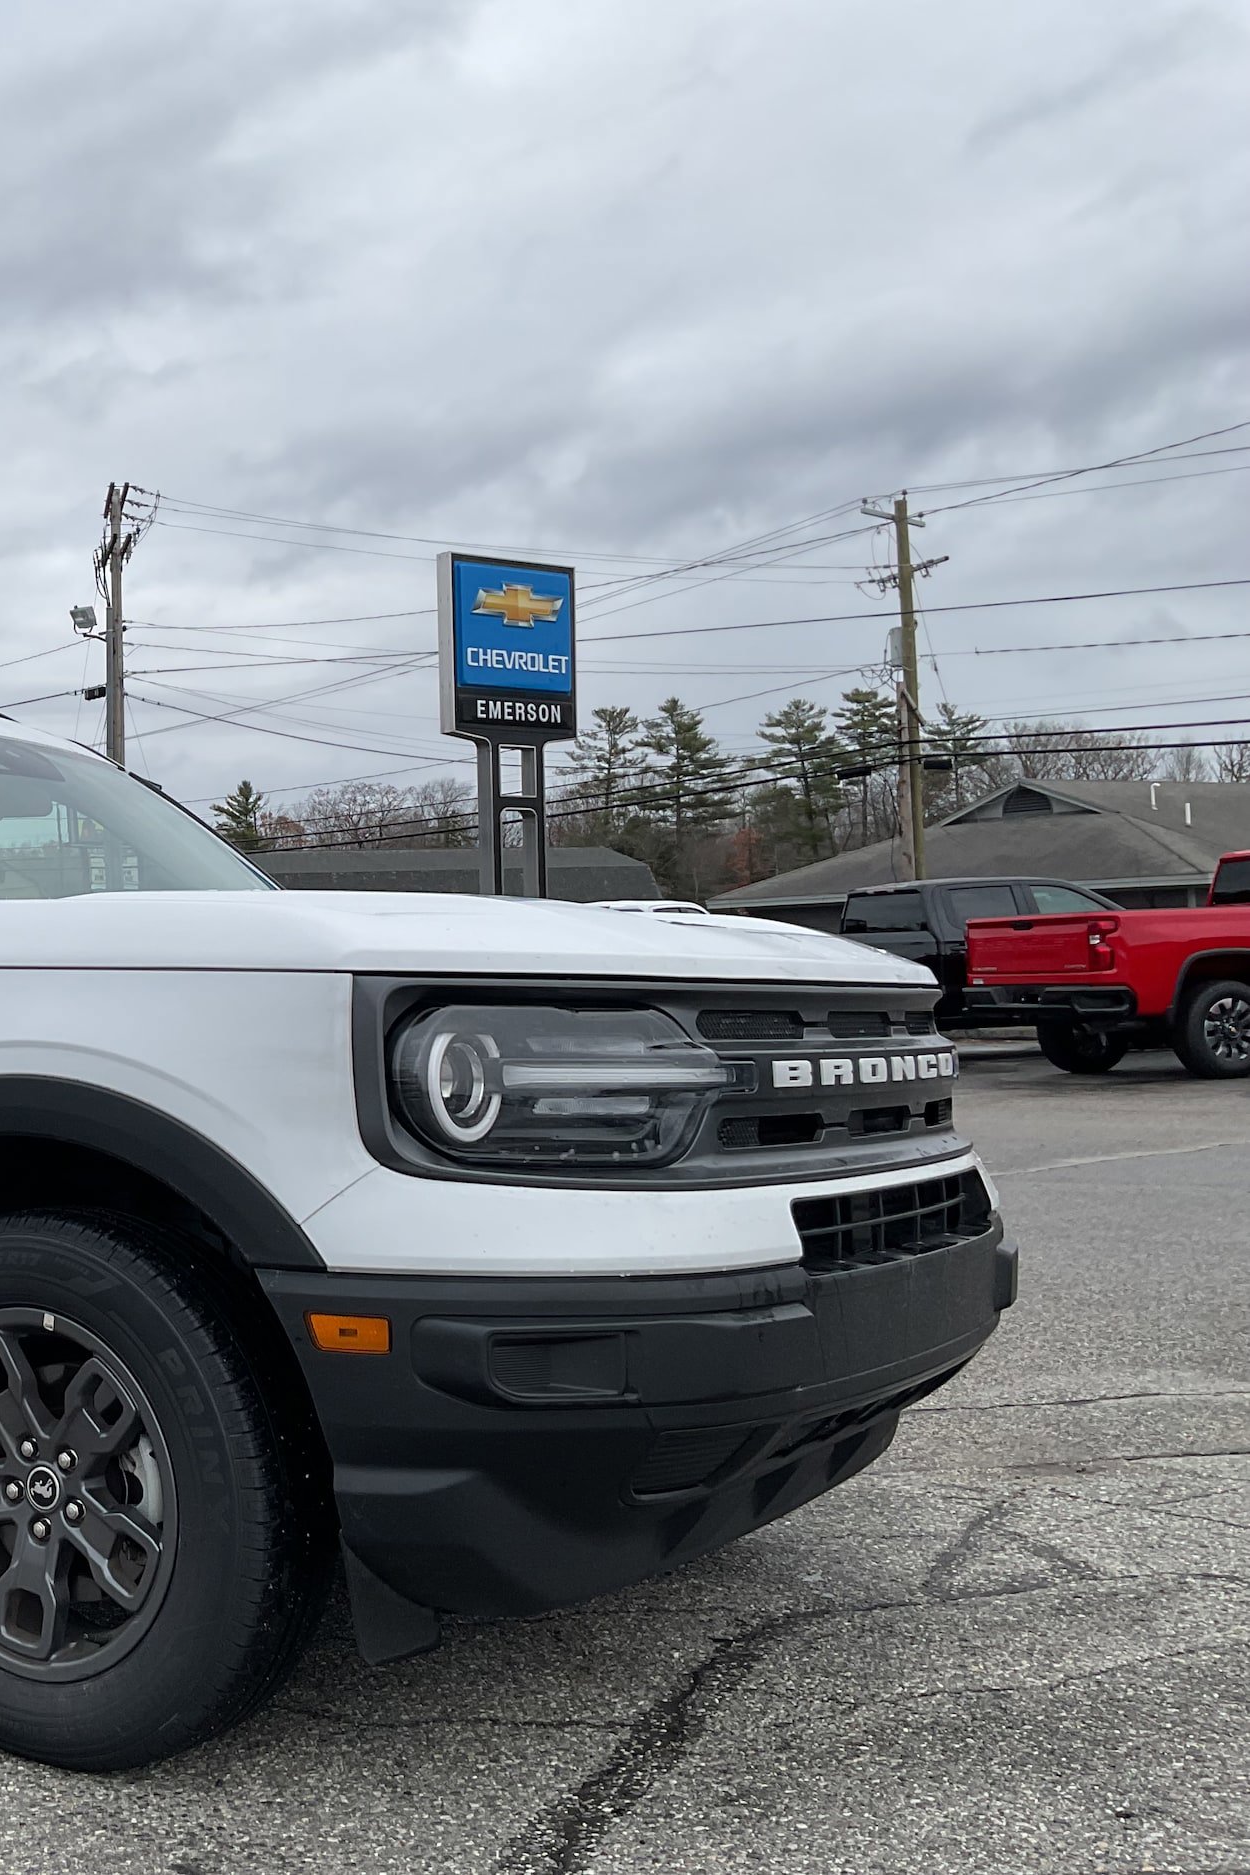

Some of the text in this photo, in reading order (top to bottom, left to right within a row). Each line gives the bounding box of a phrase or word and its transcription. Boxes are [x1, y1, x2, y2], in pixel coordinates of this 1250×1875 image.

[466, 647, 569, 674] CHEVROLET
[476, 699, 562, 724] EMERSON
[772, 1052, 956, 1088] BRONCO
